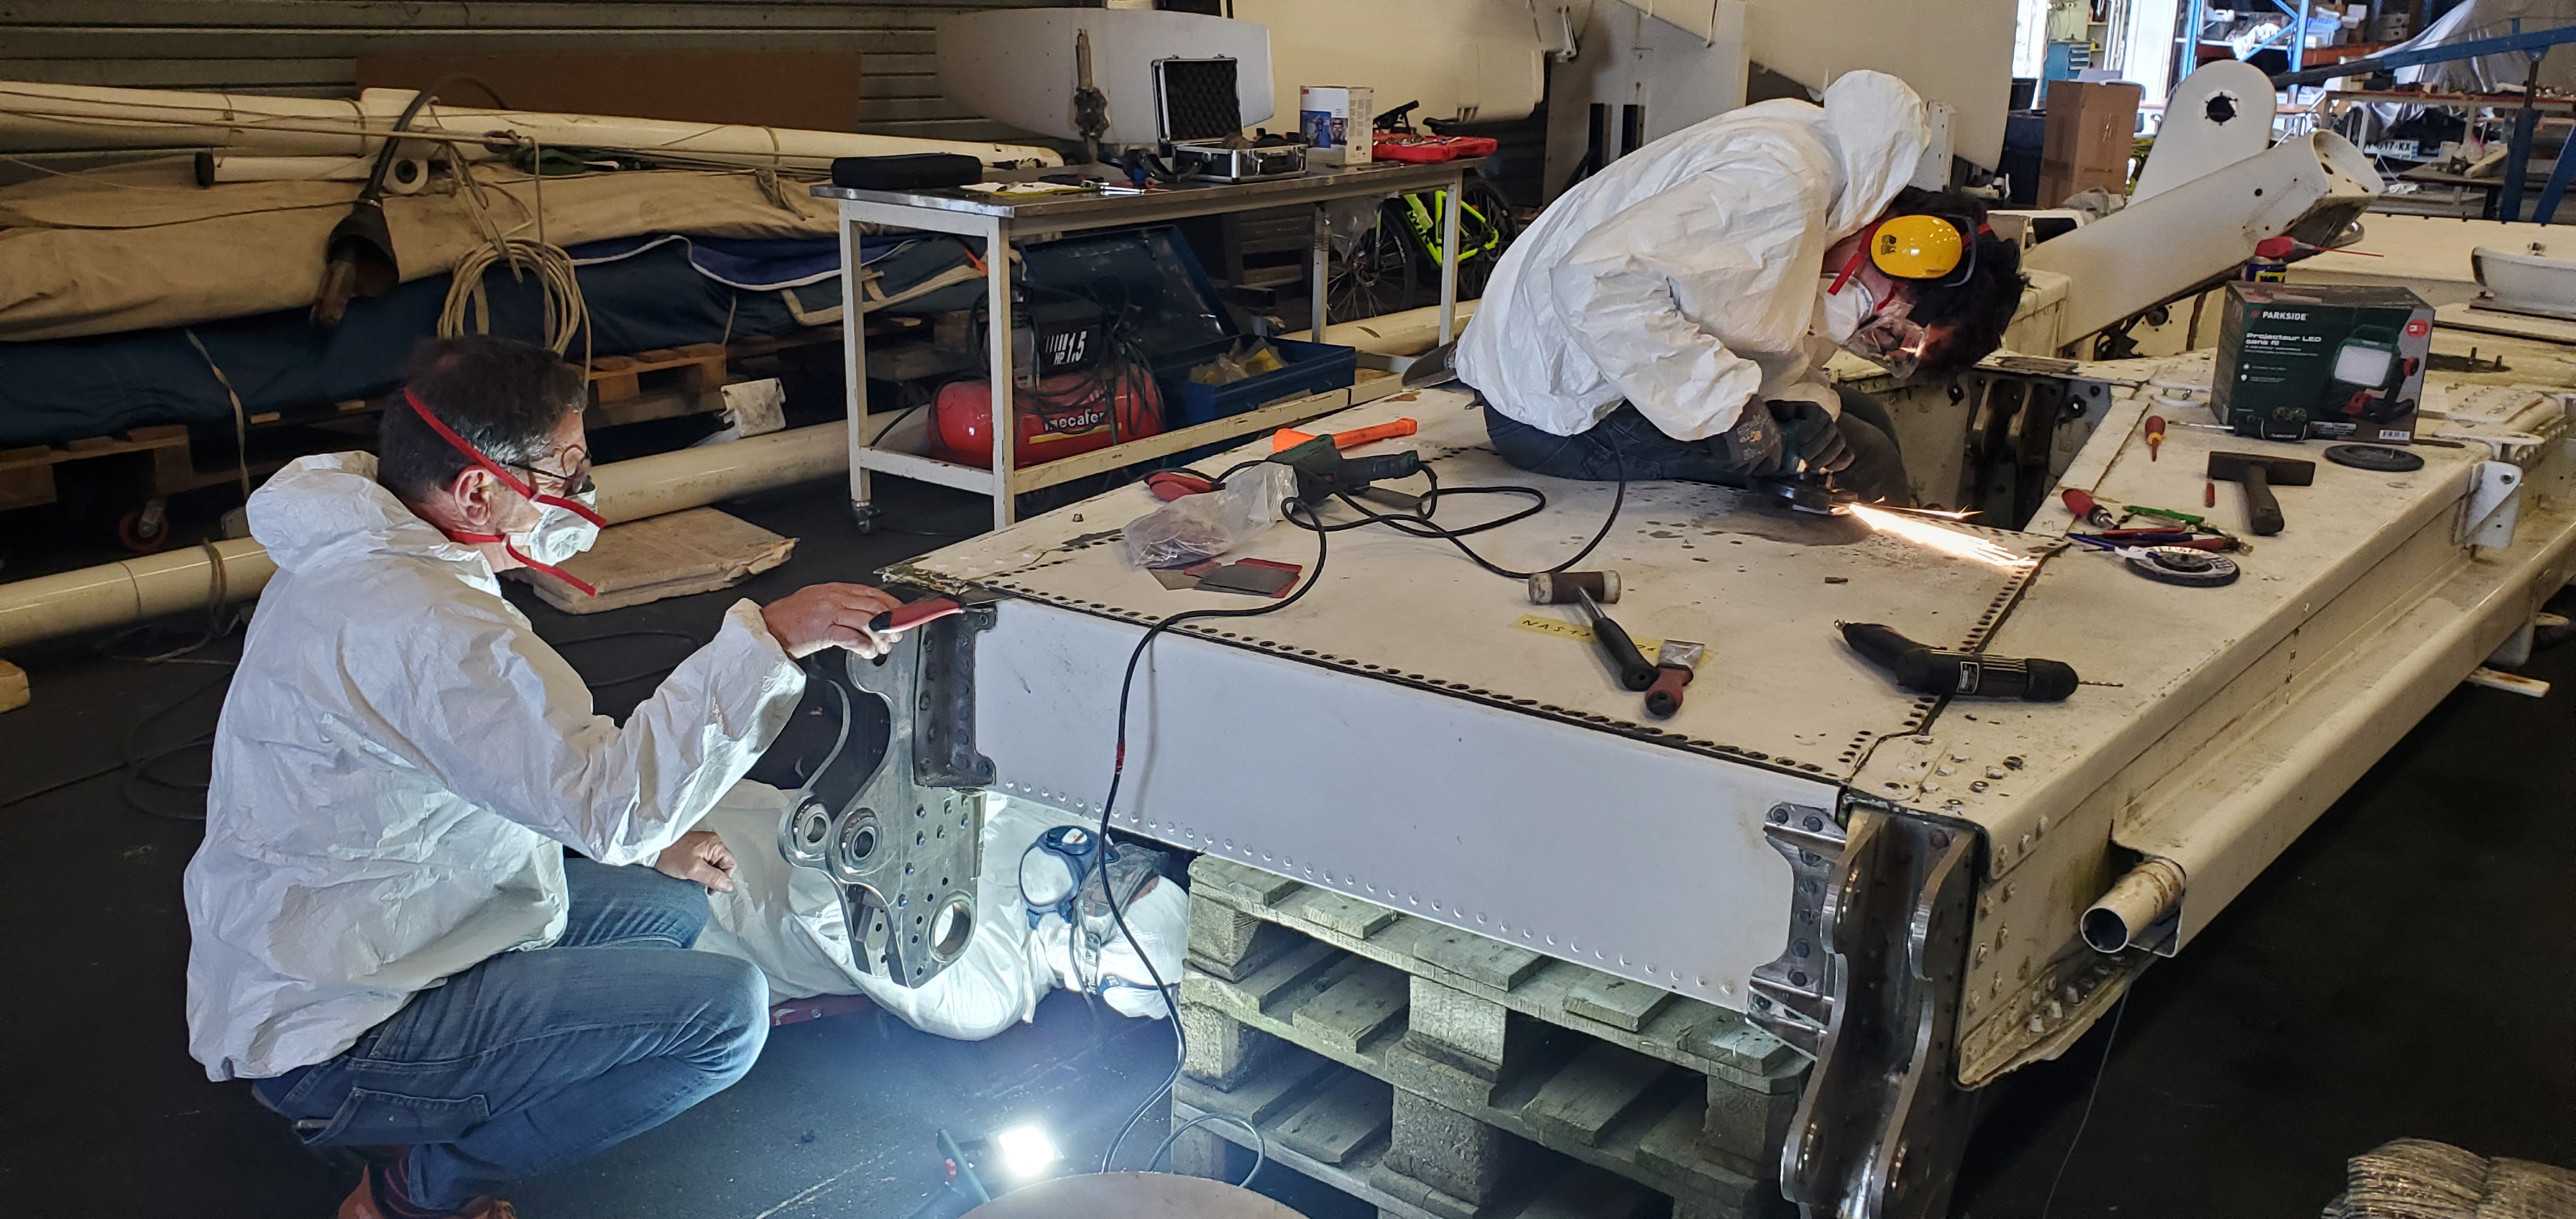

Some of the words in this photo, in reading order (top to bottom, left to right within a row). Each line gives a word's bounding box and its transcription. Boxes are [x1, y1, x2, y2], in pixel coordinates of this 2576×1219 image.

[2262, 311, 2307, 321] PARKSIDE
[2246, 333, 2300, 341] Projecteur
[1054, 351, 1066, 365] HP
[1066, 330, 1087, 363] 1.5
